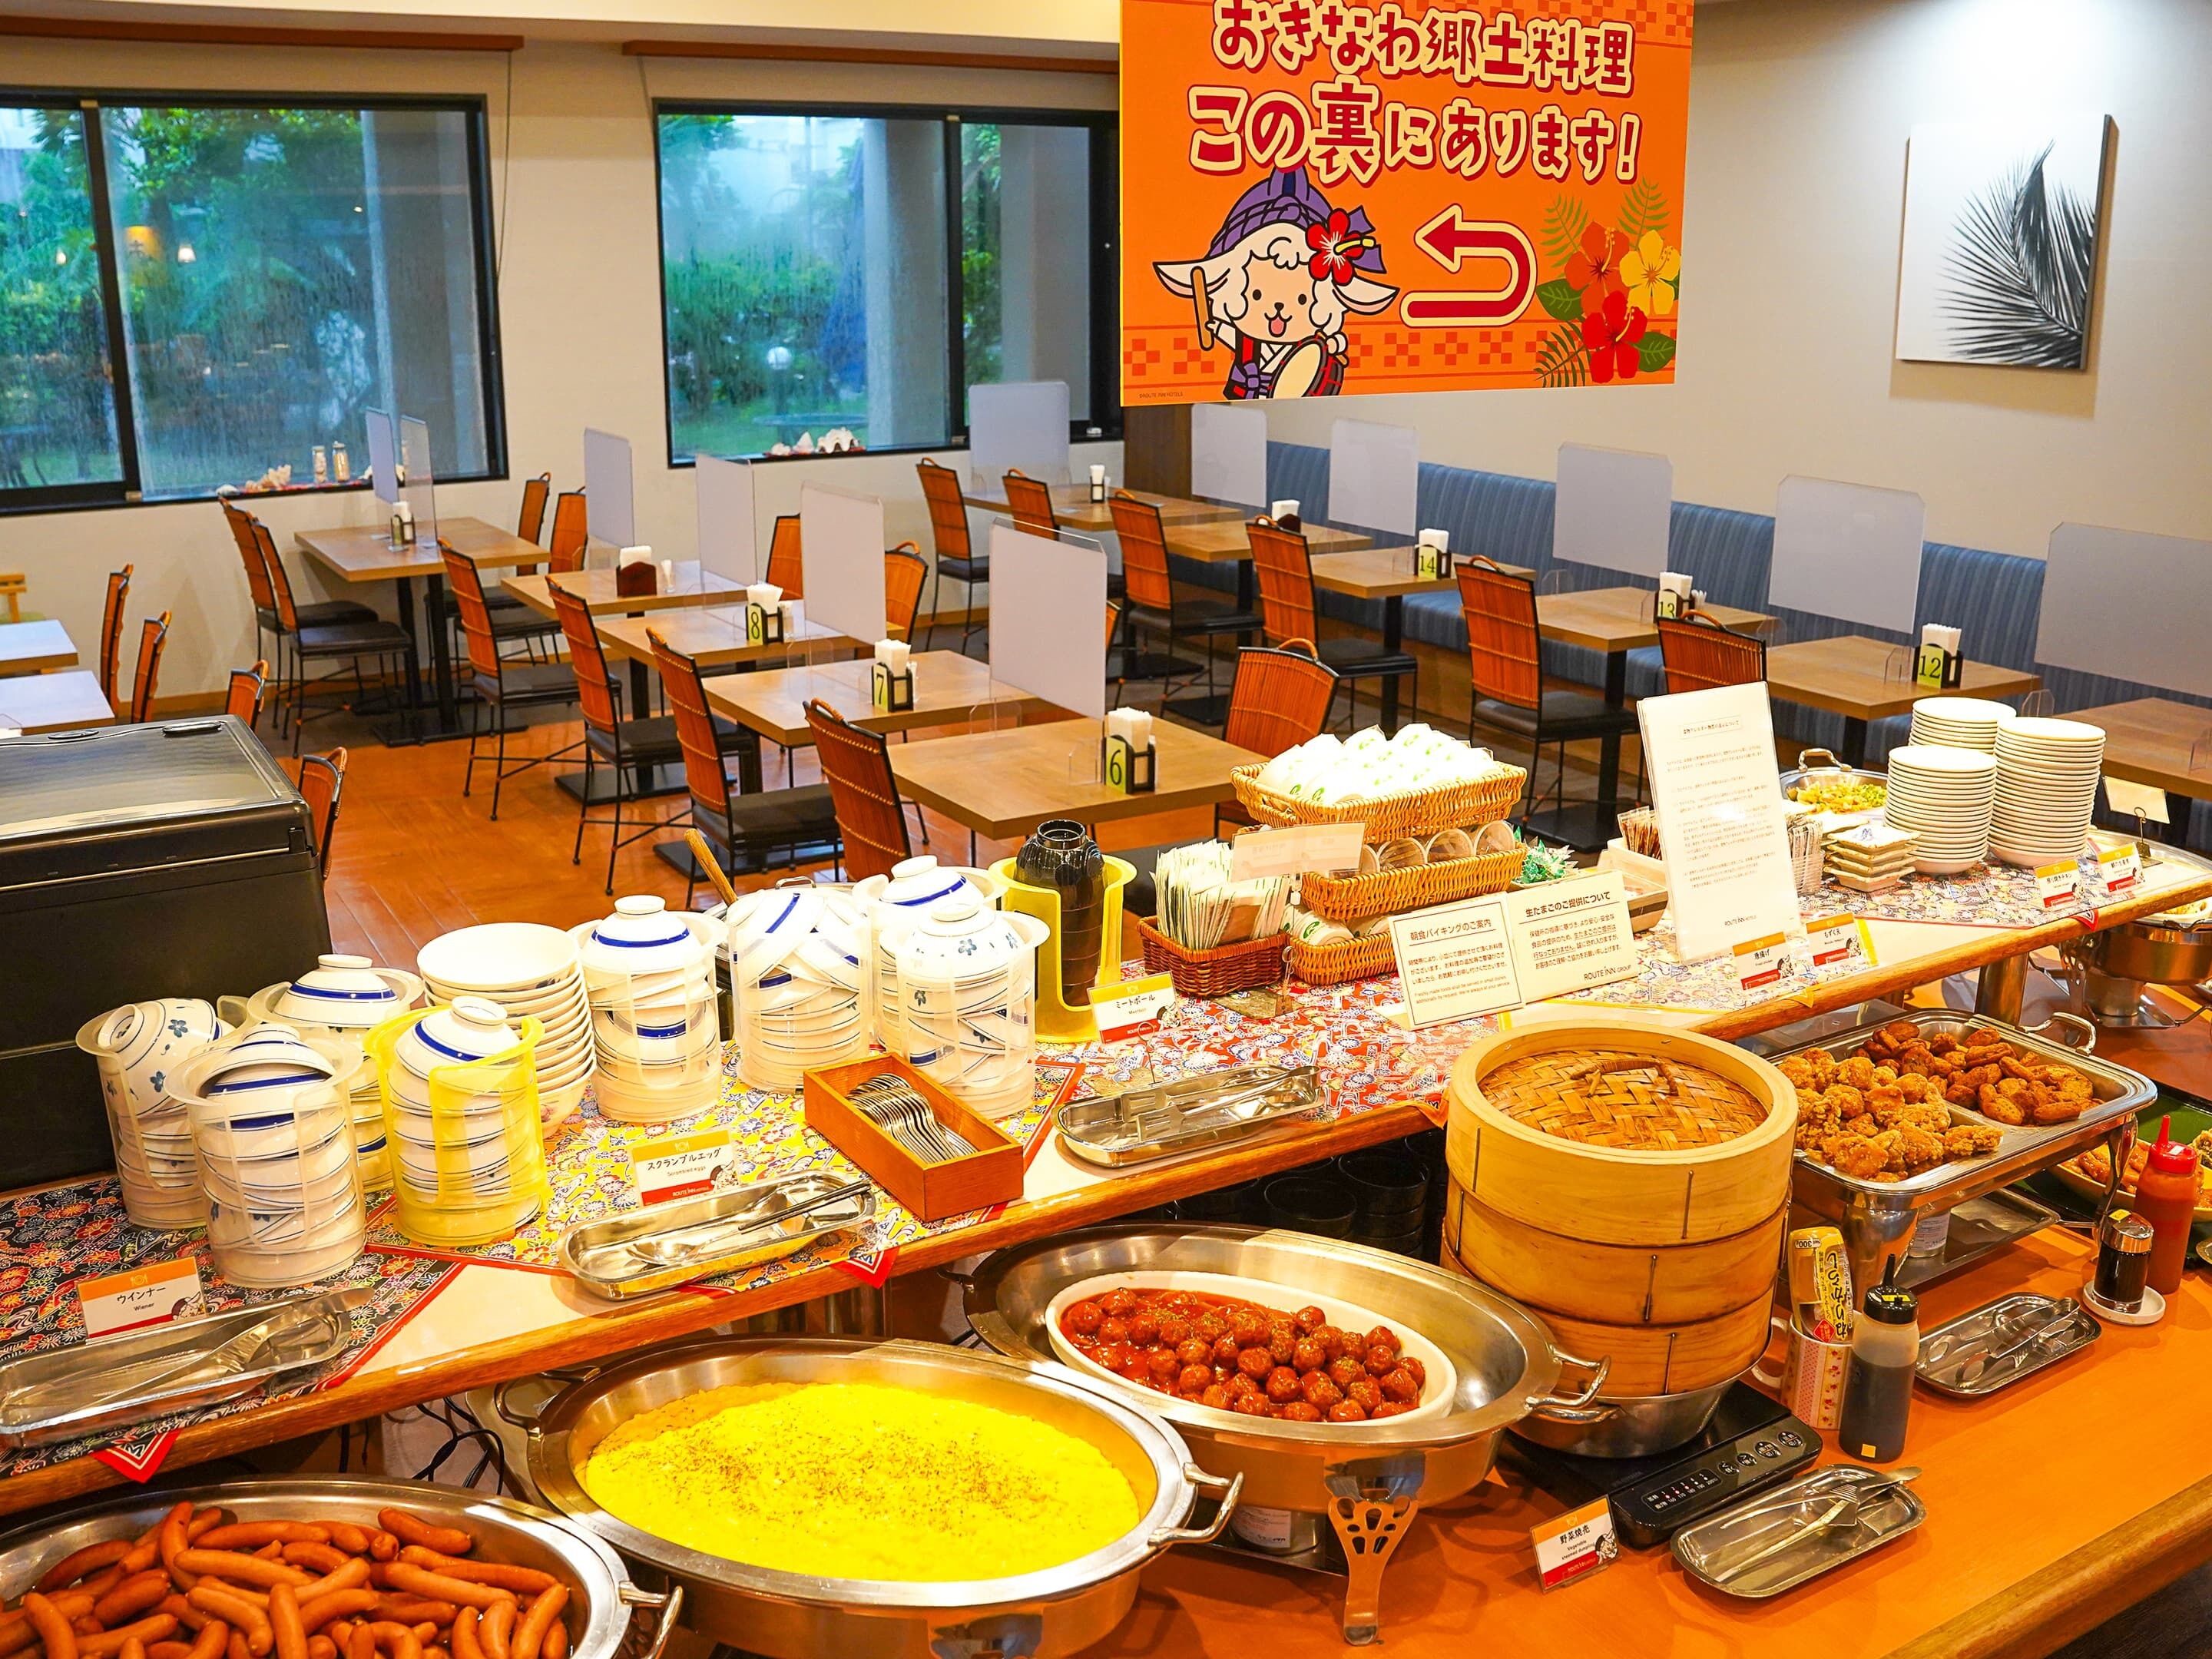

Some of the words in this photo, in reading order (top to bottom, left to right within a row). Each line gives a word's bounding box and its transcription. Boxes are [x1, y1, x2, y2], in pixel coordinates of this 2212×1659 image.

[1212, 0, 1636, 97] おきなわ郷土料理
[1419, 555, 1435, 574] 14
[1659, 601, 1675, 618] 13
[750, 611, 760, 640] 8
[1919, 654, 1941, 679] 12
[876, 672, 884, 705] 7
[1110, 749, 1122, 786] 6
[1525, 891, 1611, 917] 生たまごのご提供について
[1410, 919, 1492, 941] 朝食バイキングのご案内
[1584, 969, 1604, 981] ROUTE
[1115, 995, 1156, 1008] ミートボール
[647, 1147, 722, 1171] スクランブルエッグ
[667, 1167, 693, 1177] Scrambled
[117, 1286, 166, 1304] ウインナー
[1826, 1252, 1847, 1339] ねりからし
[134, 1303, 154, 1311] Wiener
[1560, 1525, 1590, 1545] 野菜焼売
[1561, 1551, 1578, 1560] steamed
[1567, 1540, 1587, 1551] Vegetable
